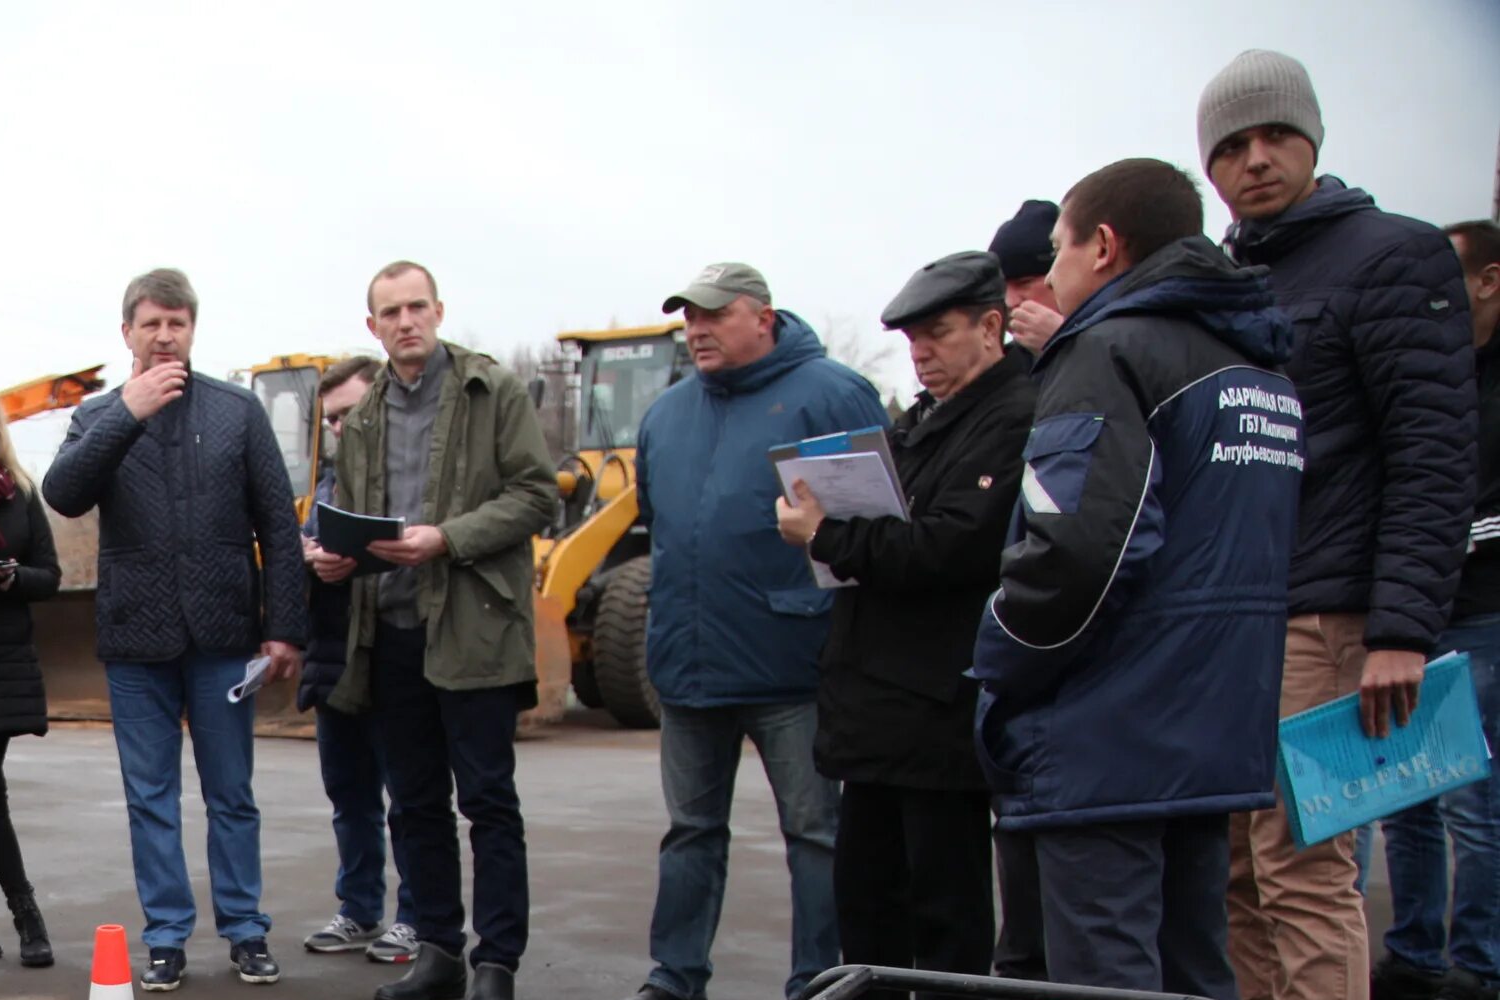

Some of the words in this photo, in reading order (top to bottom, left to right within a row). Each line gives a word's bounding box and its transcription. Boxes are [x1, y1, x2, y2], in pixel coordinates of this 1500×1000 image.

[1219, 385, 1277, 412] АВАРИЙНАЯ
[1239, 414, 1259, 433] ГБУ
[1211, 441, 1285, 465] Алтуфьевского
[1342, 754, 1431, 799] CLEAR
